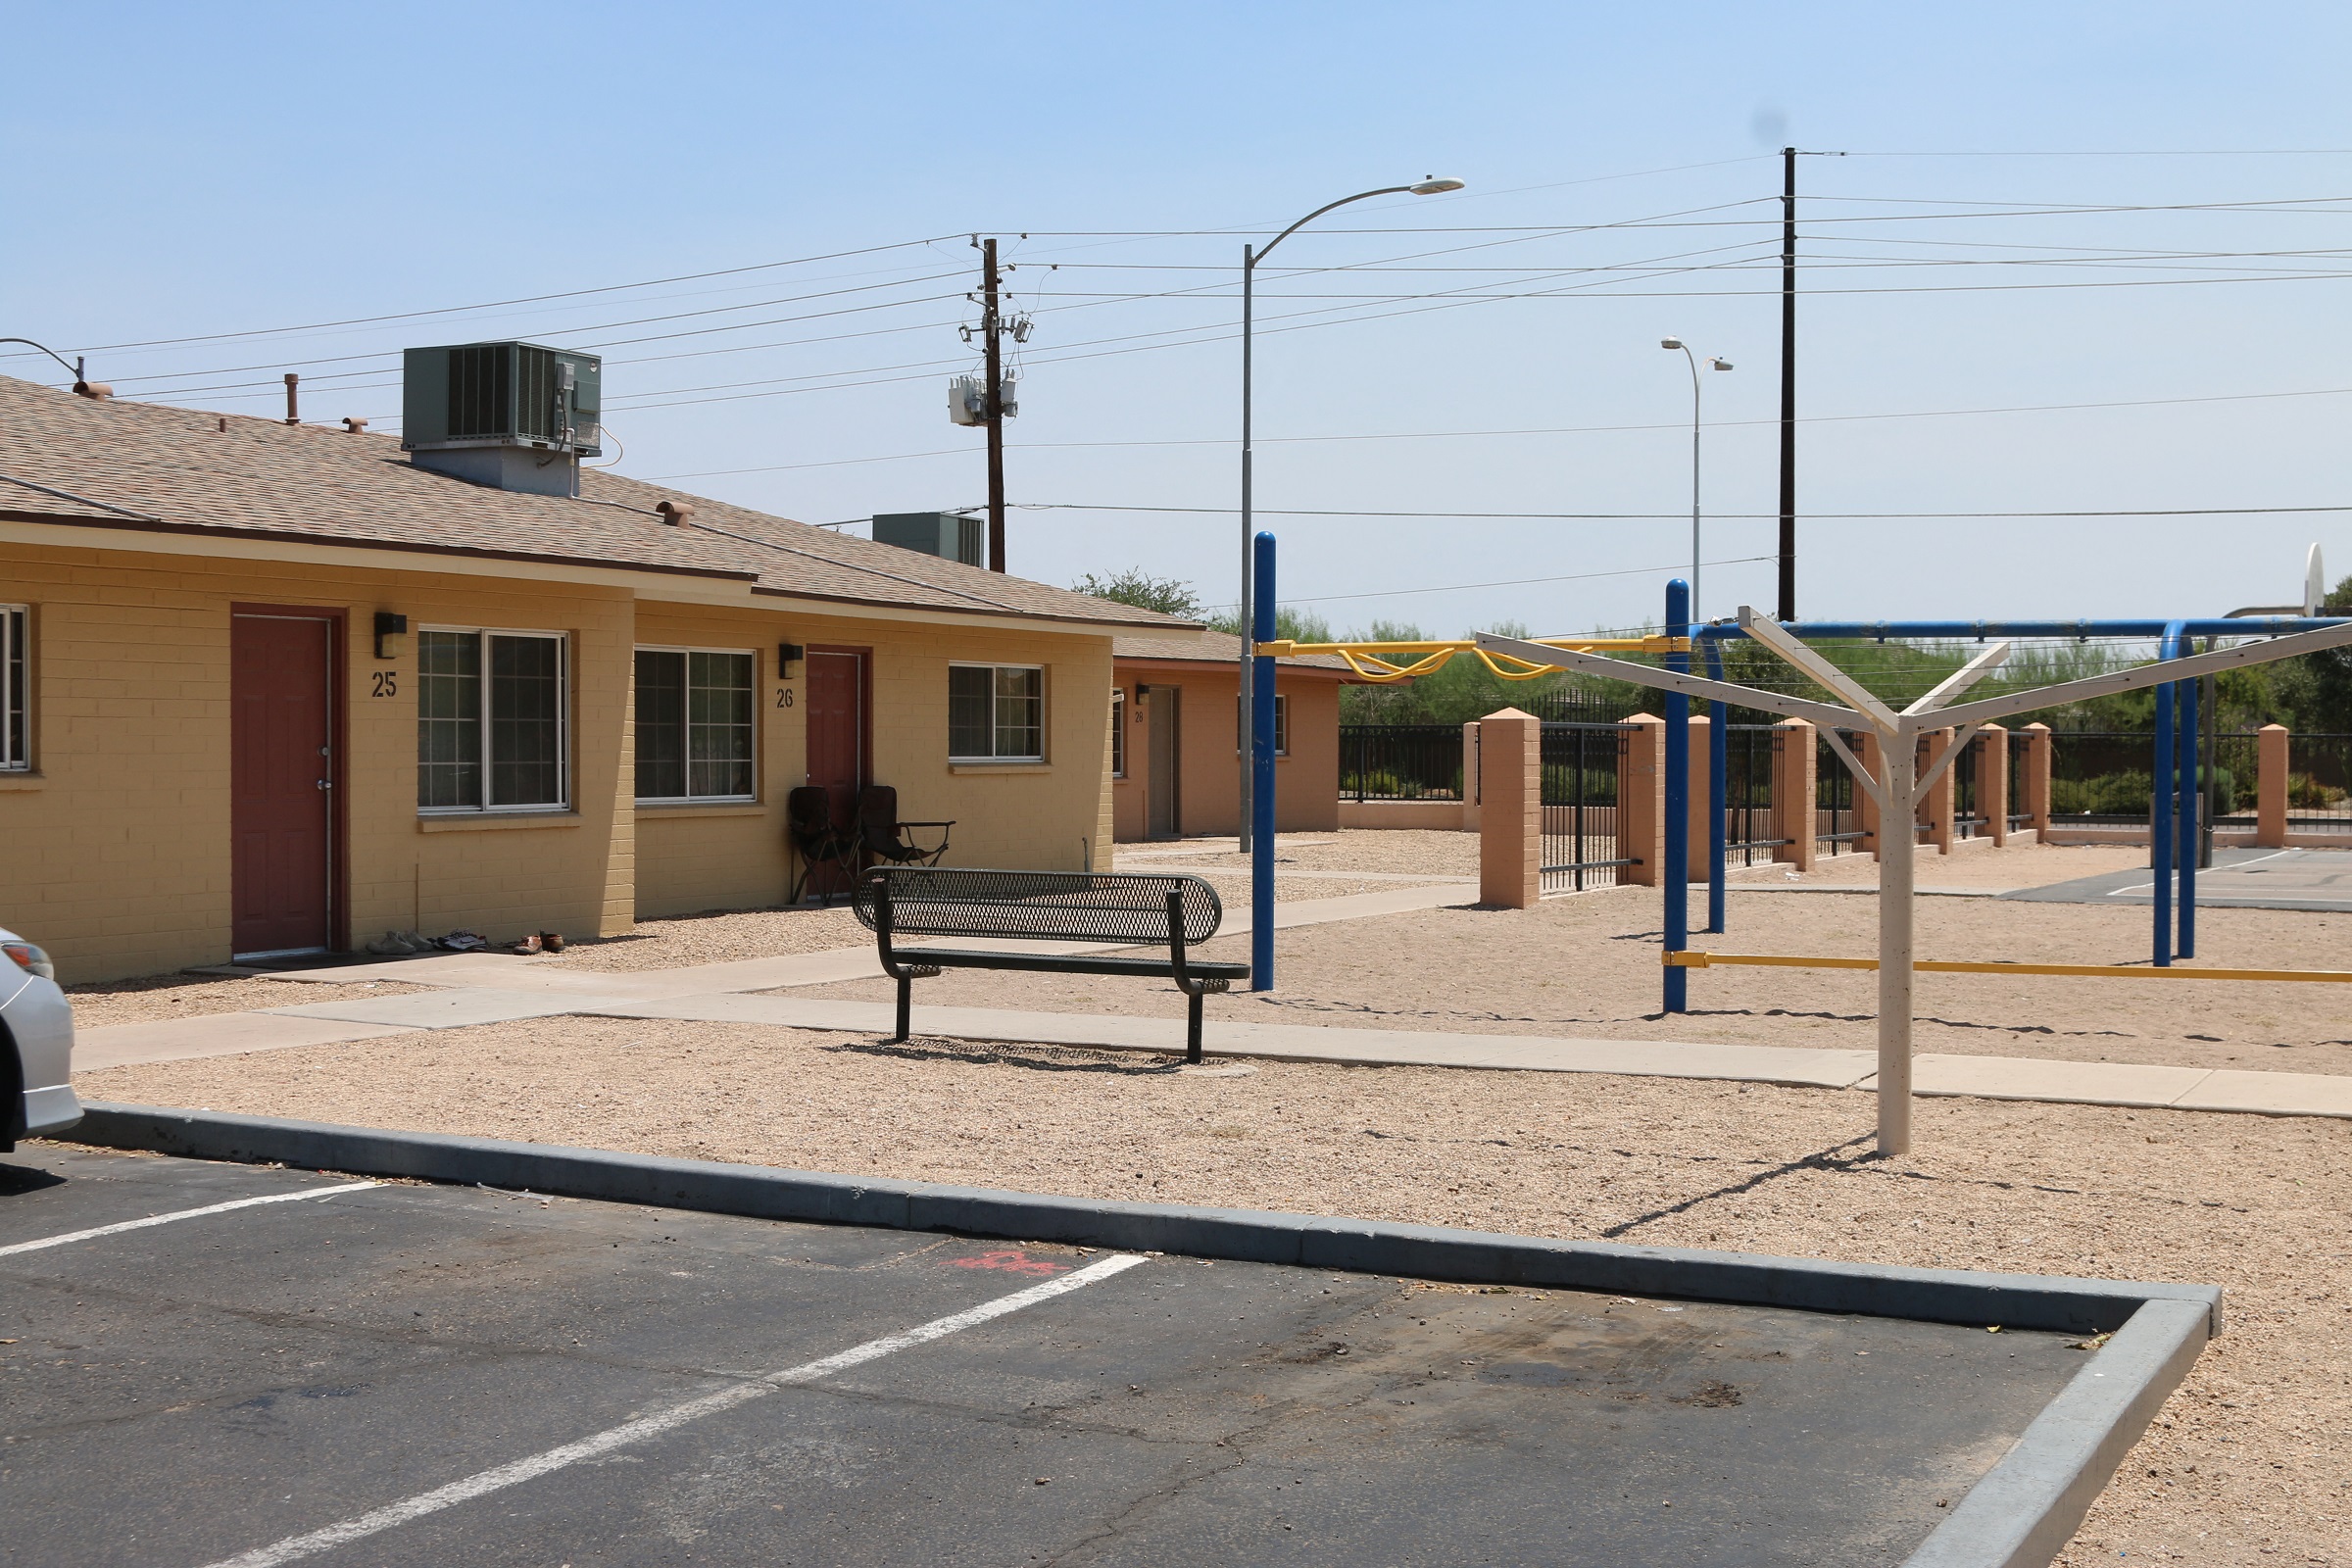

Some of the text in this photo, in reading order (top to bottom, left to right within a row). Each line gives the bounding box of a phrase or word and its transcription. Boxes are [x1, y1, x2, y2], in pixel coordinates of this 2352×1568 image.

[372, 671, 397, 697] 25
[776, 688, 793, 708] 26
[1135, 710, 1144, 722] 28
